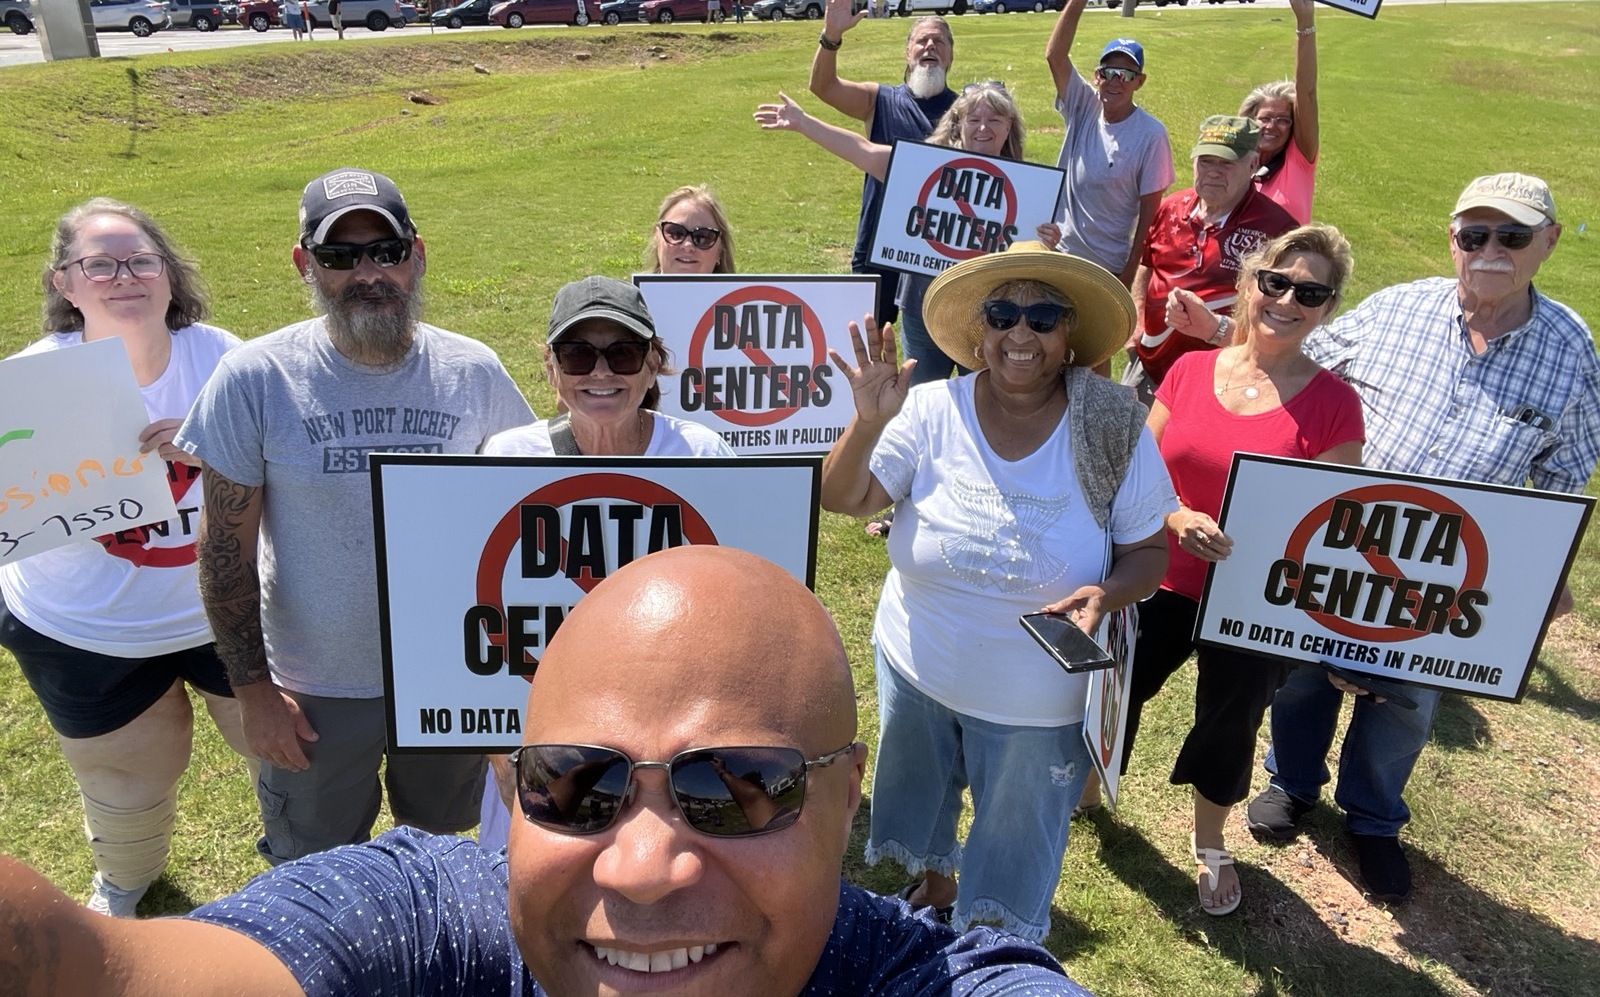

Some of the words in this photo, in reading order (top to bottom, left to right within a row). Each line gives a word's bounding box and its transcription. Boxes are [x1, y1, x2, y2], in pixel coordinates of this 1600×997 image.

[937, 167, 1004, 209] DATA
[906, 206, 1018, 253] CENTERS
[1232, 232, 1262, 251] USA
[881, 246, 894, 260] NO
[896, 249, 920, 266] DATA
[923, 256, 956, 271] CENTE
[714, 305, 804, 349] DATA
[680, 365, 833, 412] CENTERS
[303, 411, 346, 445] NEW
[352, 407, 396, 436] PORT
[401, 408, 461, 440] RICHEY
[775, 429, 788, 445] IN
[792, 427, 845, 444] PAULDIN
[520, 505, 683, 578] DATA
[1323, 499, 1463, 566] DATA
[1263, 559, 1489, 639] CENTERS
[1219, 617, 1242, 638] NO
[1248, 624, 1294, 649] DATA
[1299, 634, 1380, 664] CENTERS
[1384, 651, 1405, 669] IN
[1409, 653, 1503, 686] PAULDING
[420, 708, 452, 734] NO
[461, 708, 521, 734] DATA
